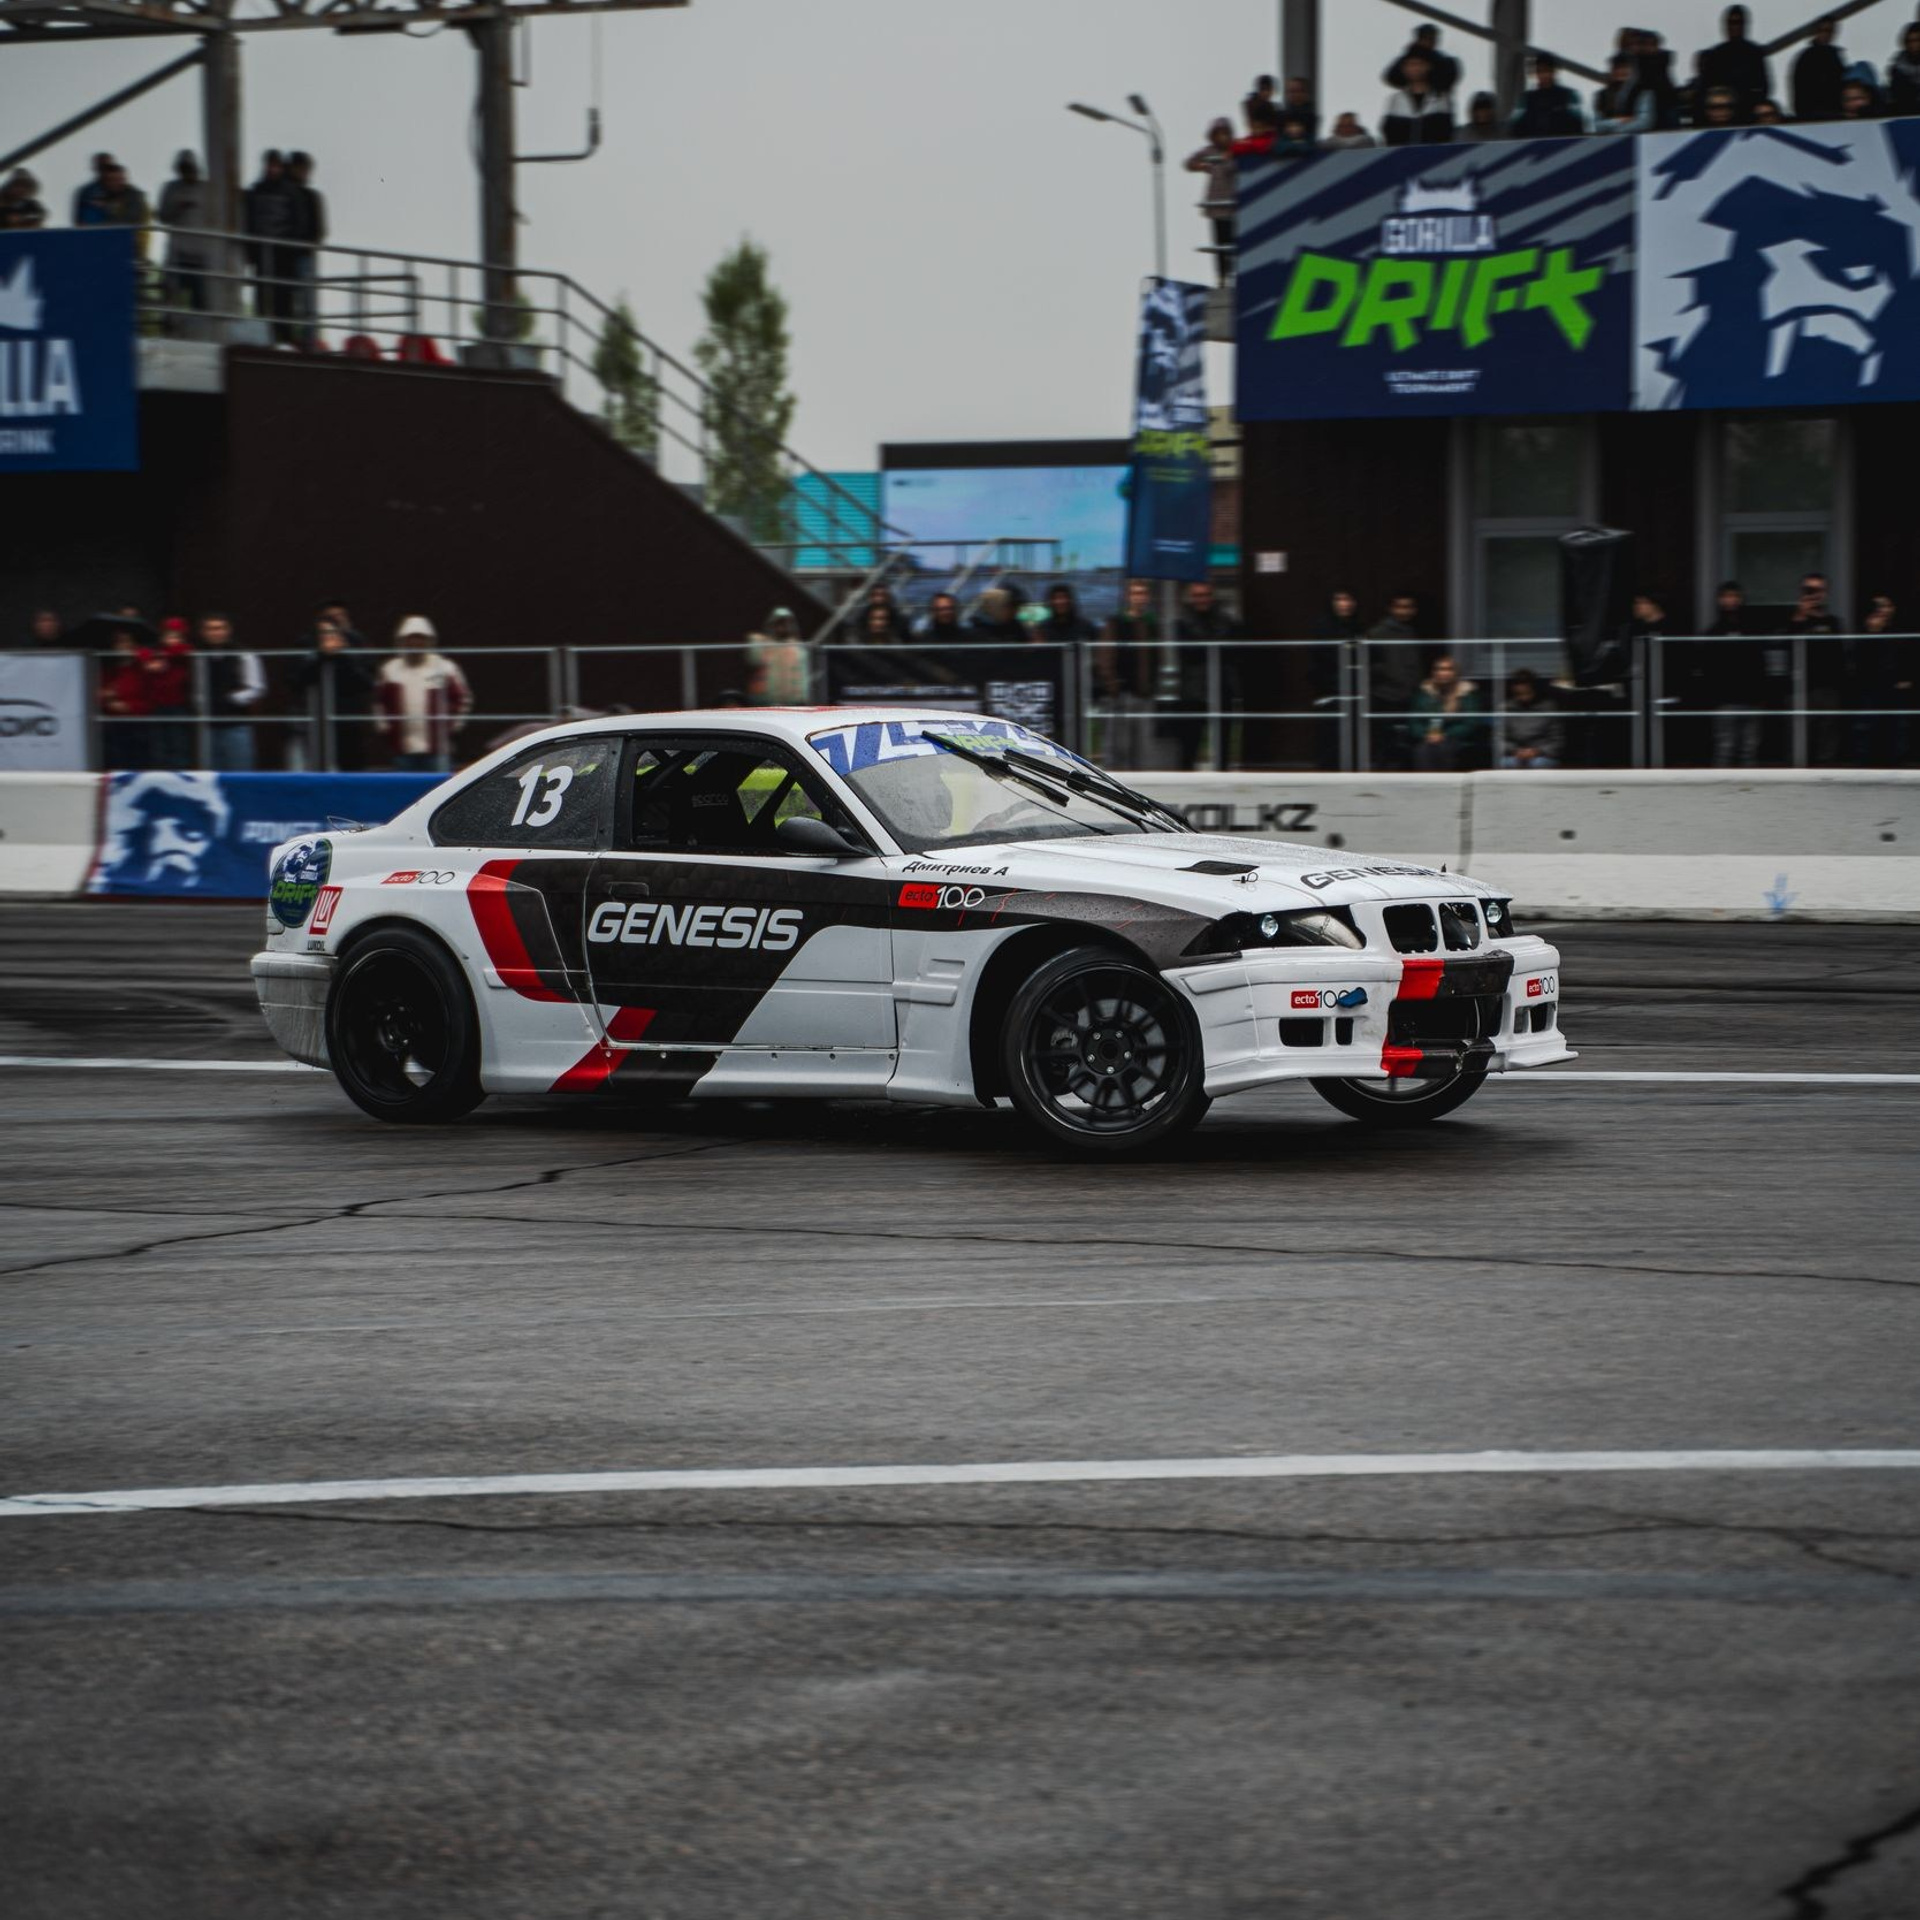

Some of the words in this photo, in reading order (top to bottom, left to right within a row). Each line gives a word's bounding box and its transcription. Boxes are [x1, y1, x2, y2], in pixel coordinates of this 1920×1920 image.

[1381, 214, 1495, 254] GORILLA
[1267, 248, 1604, 351] DRIFT
[511, 764, 574, 827] 13
[902, 861, 991, 876] Дмитриев
[587, 901, 803, 950] GENESIS
